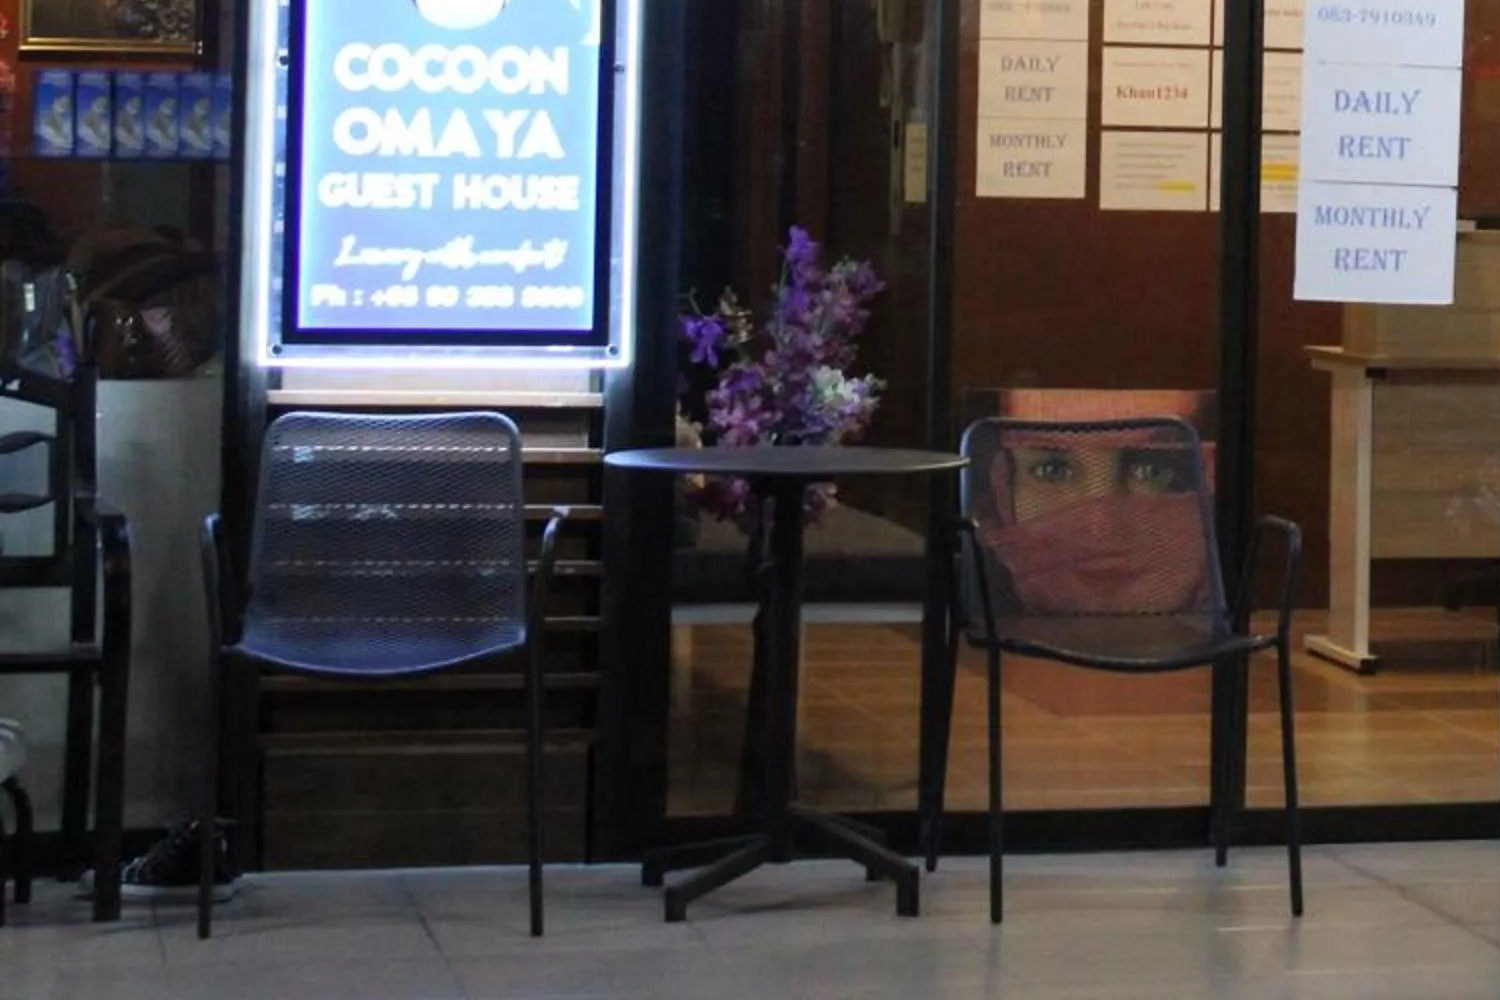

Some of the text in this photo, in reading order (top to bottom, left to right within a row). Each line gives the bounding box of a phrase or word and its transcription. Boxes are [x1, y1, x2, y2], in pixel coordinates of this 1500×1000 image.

[332, 43, 570, 96] COCOON
[1001, 55, 1061, 74] DAILY
[1004, 85, 1056, 102] RENT
[1334, 88, 1423, 114] DAILY
[989, 133, 1068, 149] MONTHLY
[1337, 134, 1412, 160] RENT
[1003, 161, 1054, 178] RENT
[318, 171, 579, 212] GUEST HOUSE
[1314, 205, 1431, 230] MONTHLY
[1333, 247, 1408, 273] RENT
